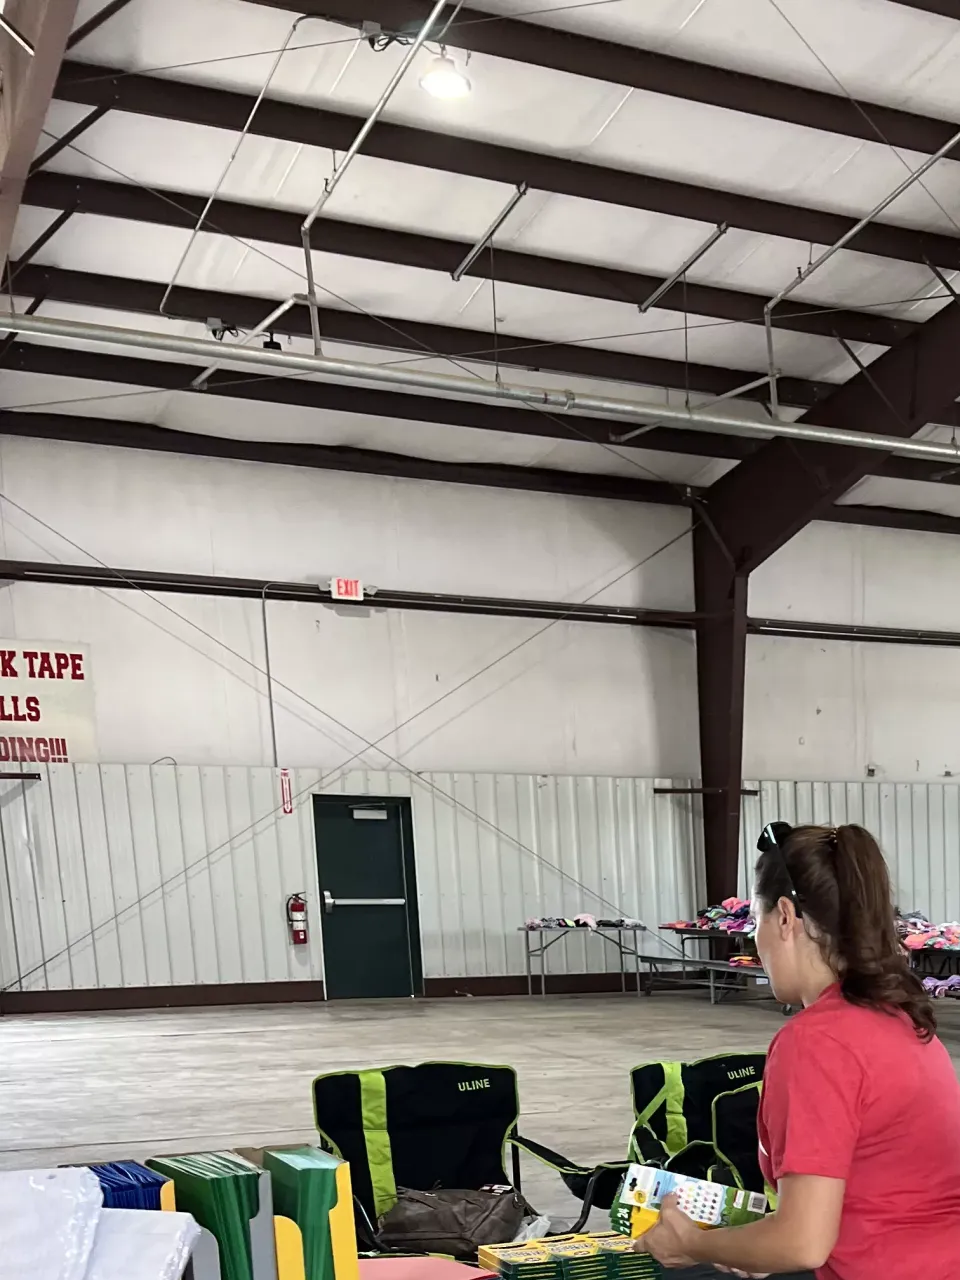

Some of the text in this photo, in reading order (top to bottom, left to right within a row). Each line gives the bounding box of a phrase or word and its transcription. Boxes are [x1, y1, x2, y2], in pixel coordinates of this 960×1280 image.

[336, 578, 359, 597] EXIT
[22, 651, 85, 680] TAPE
[726, 1065, 756, 1080] ULINE
[457, 1078, 491, 1092] ULINE
